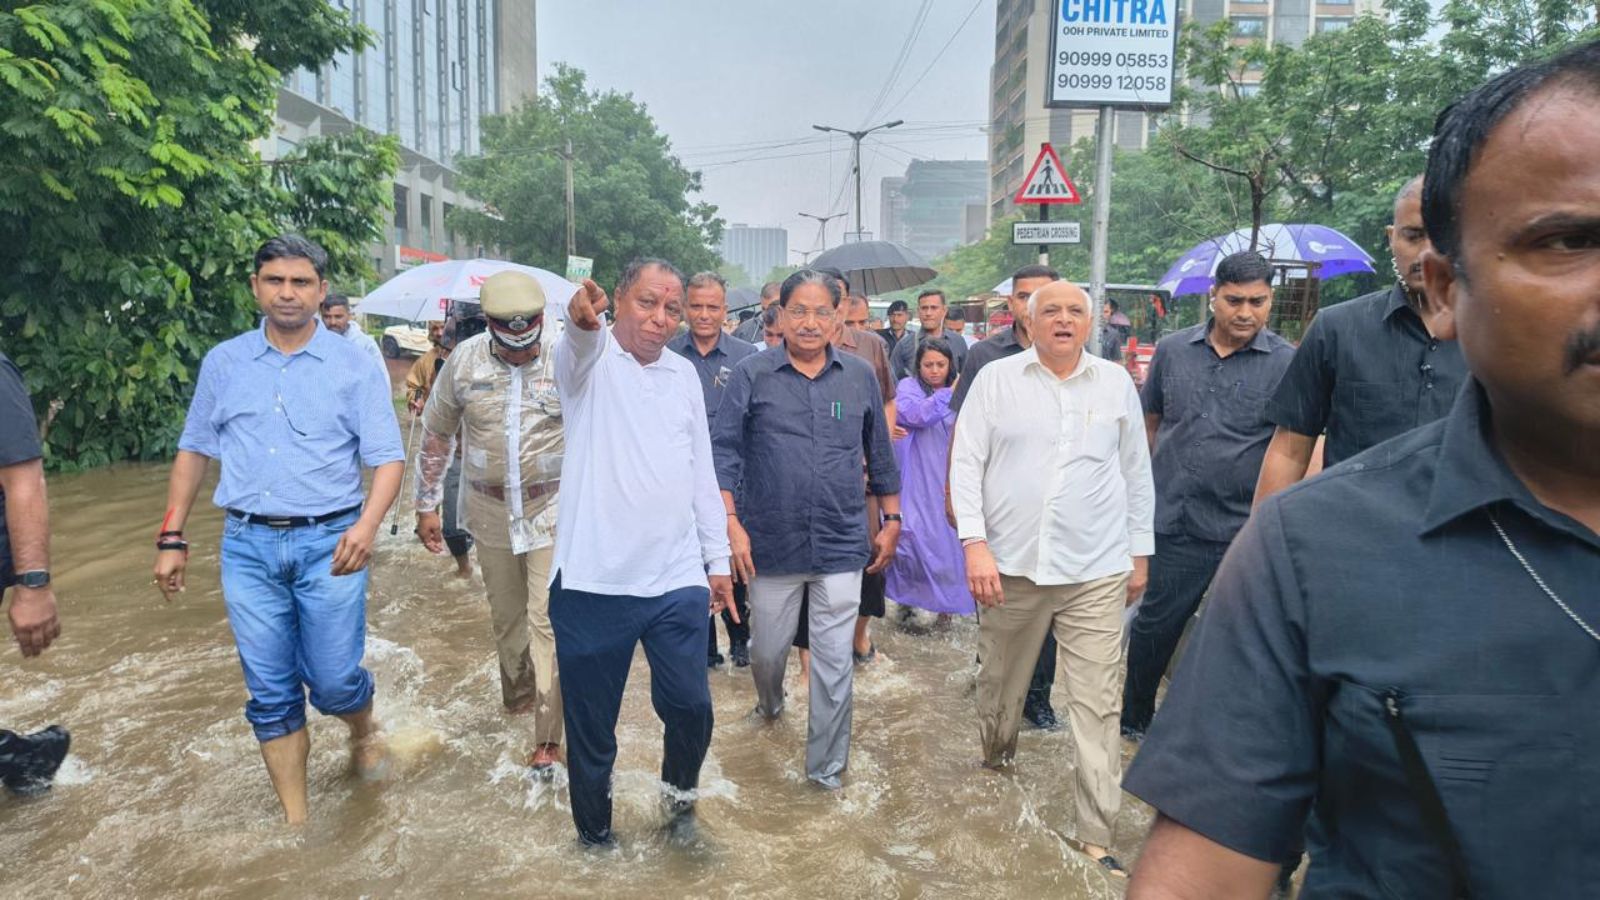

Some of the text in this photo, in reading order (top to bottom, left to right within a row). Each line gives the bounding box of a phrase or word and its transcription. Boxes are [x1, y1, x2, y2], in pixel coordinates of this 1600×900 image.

[1062, 0, 1166, 24] CHITRA
[1063, 26, 1169, 38] OOH PRIVATE LIMITED
[1059, 51, 1168, 68] 90999 05853
[1058, 74, 1166, 91] 90999 12058
